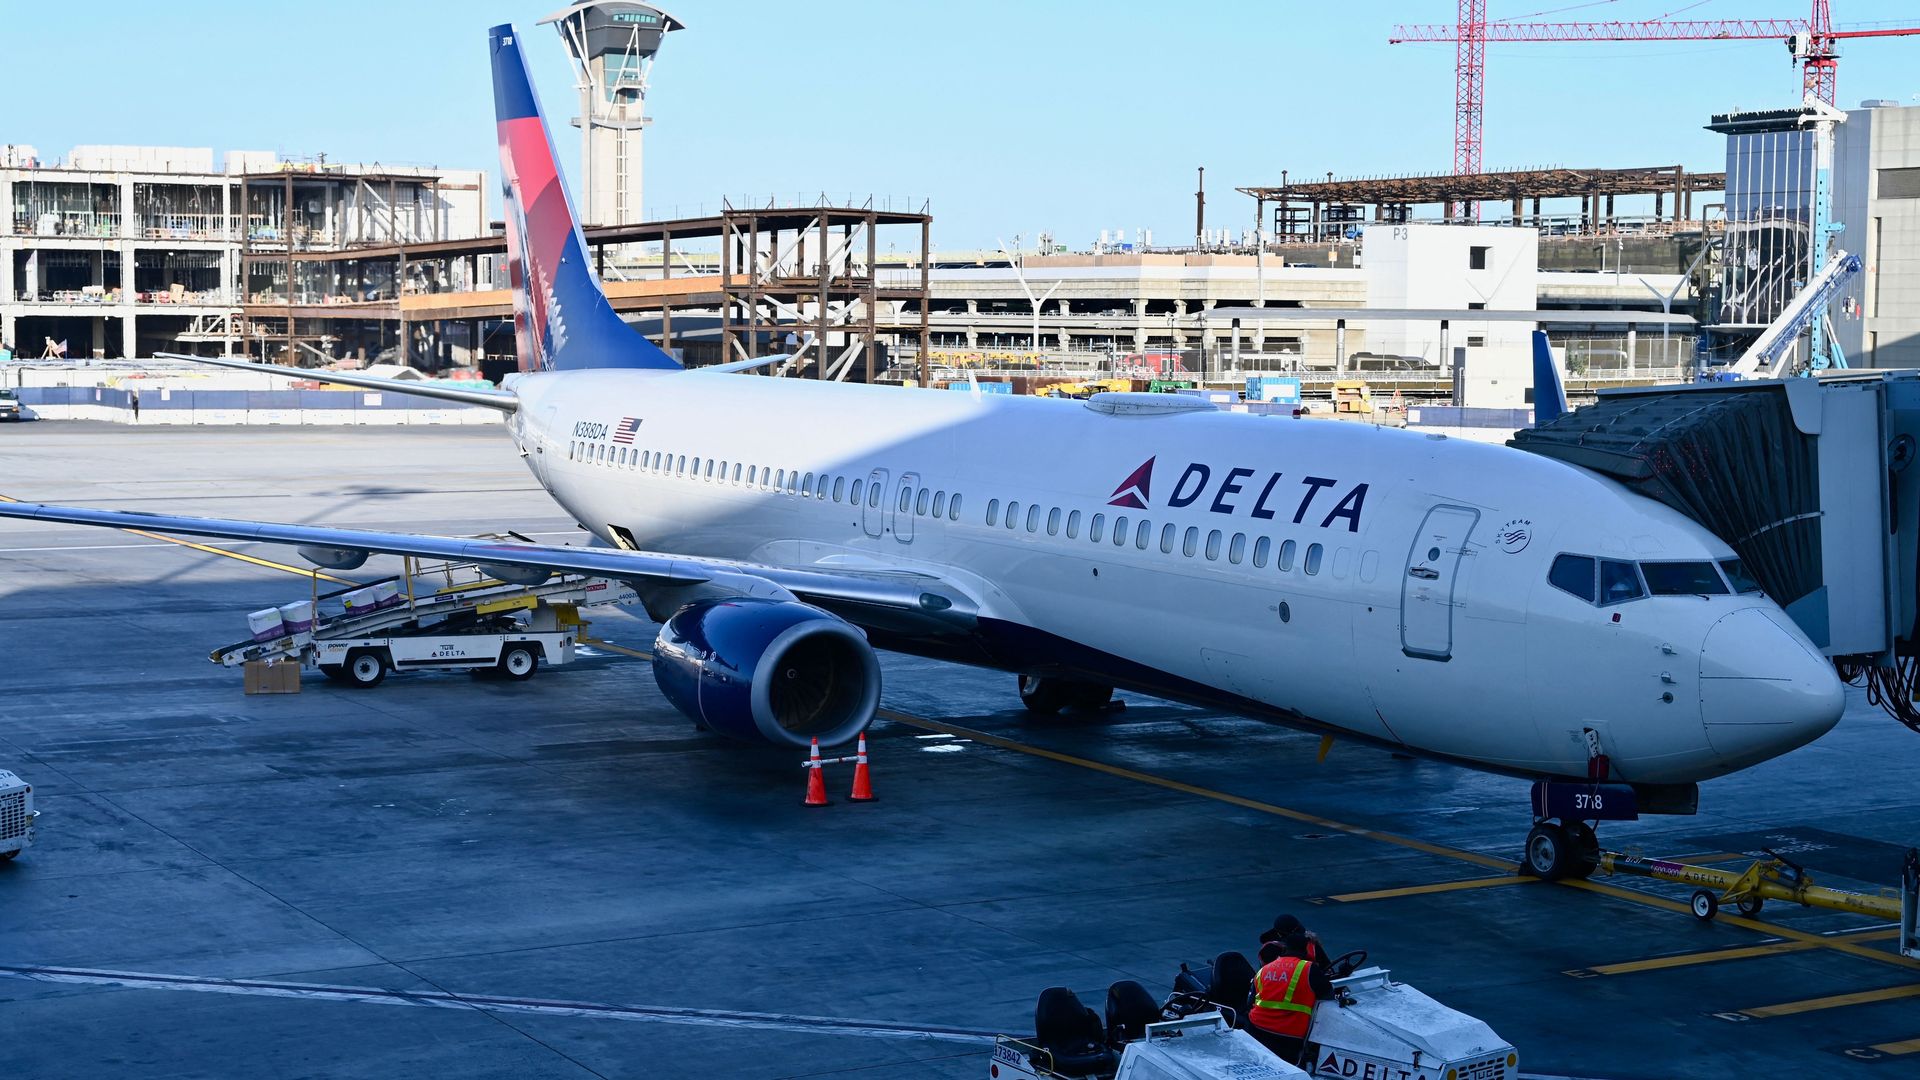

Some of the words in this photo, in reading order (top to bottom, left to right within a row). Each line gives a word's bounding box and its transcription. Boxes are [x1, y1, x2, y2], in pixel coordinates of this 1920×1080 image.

[1393, 227, 1408, 240] P3
[572, 420, 609, 440] N388DA
[1167, 463, 1370, 533] DELTA
[1495, 519, 1532, 545] SKYTEAM
[1575, 794, 1602, 809] 3718
[1693, 873, 1725, 885] DELTA
[1264, 971, 1288, 982] ALA
[994, 1046, 1021, 1065] 173842
[1341, 1058, 1427, 1080] DELT
